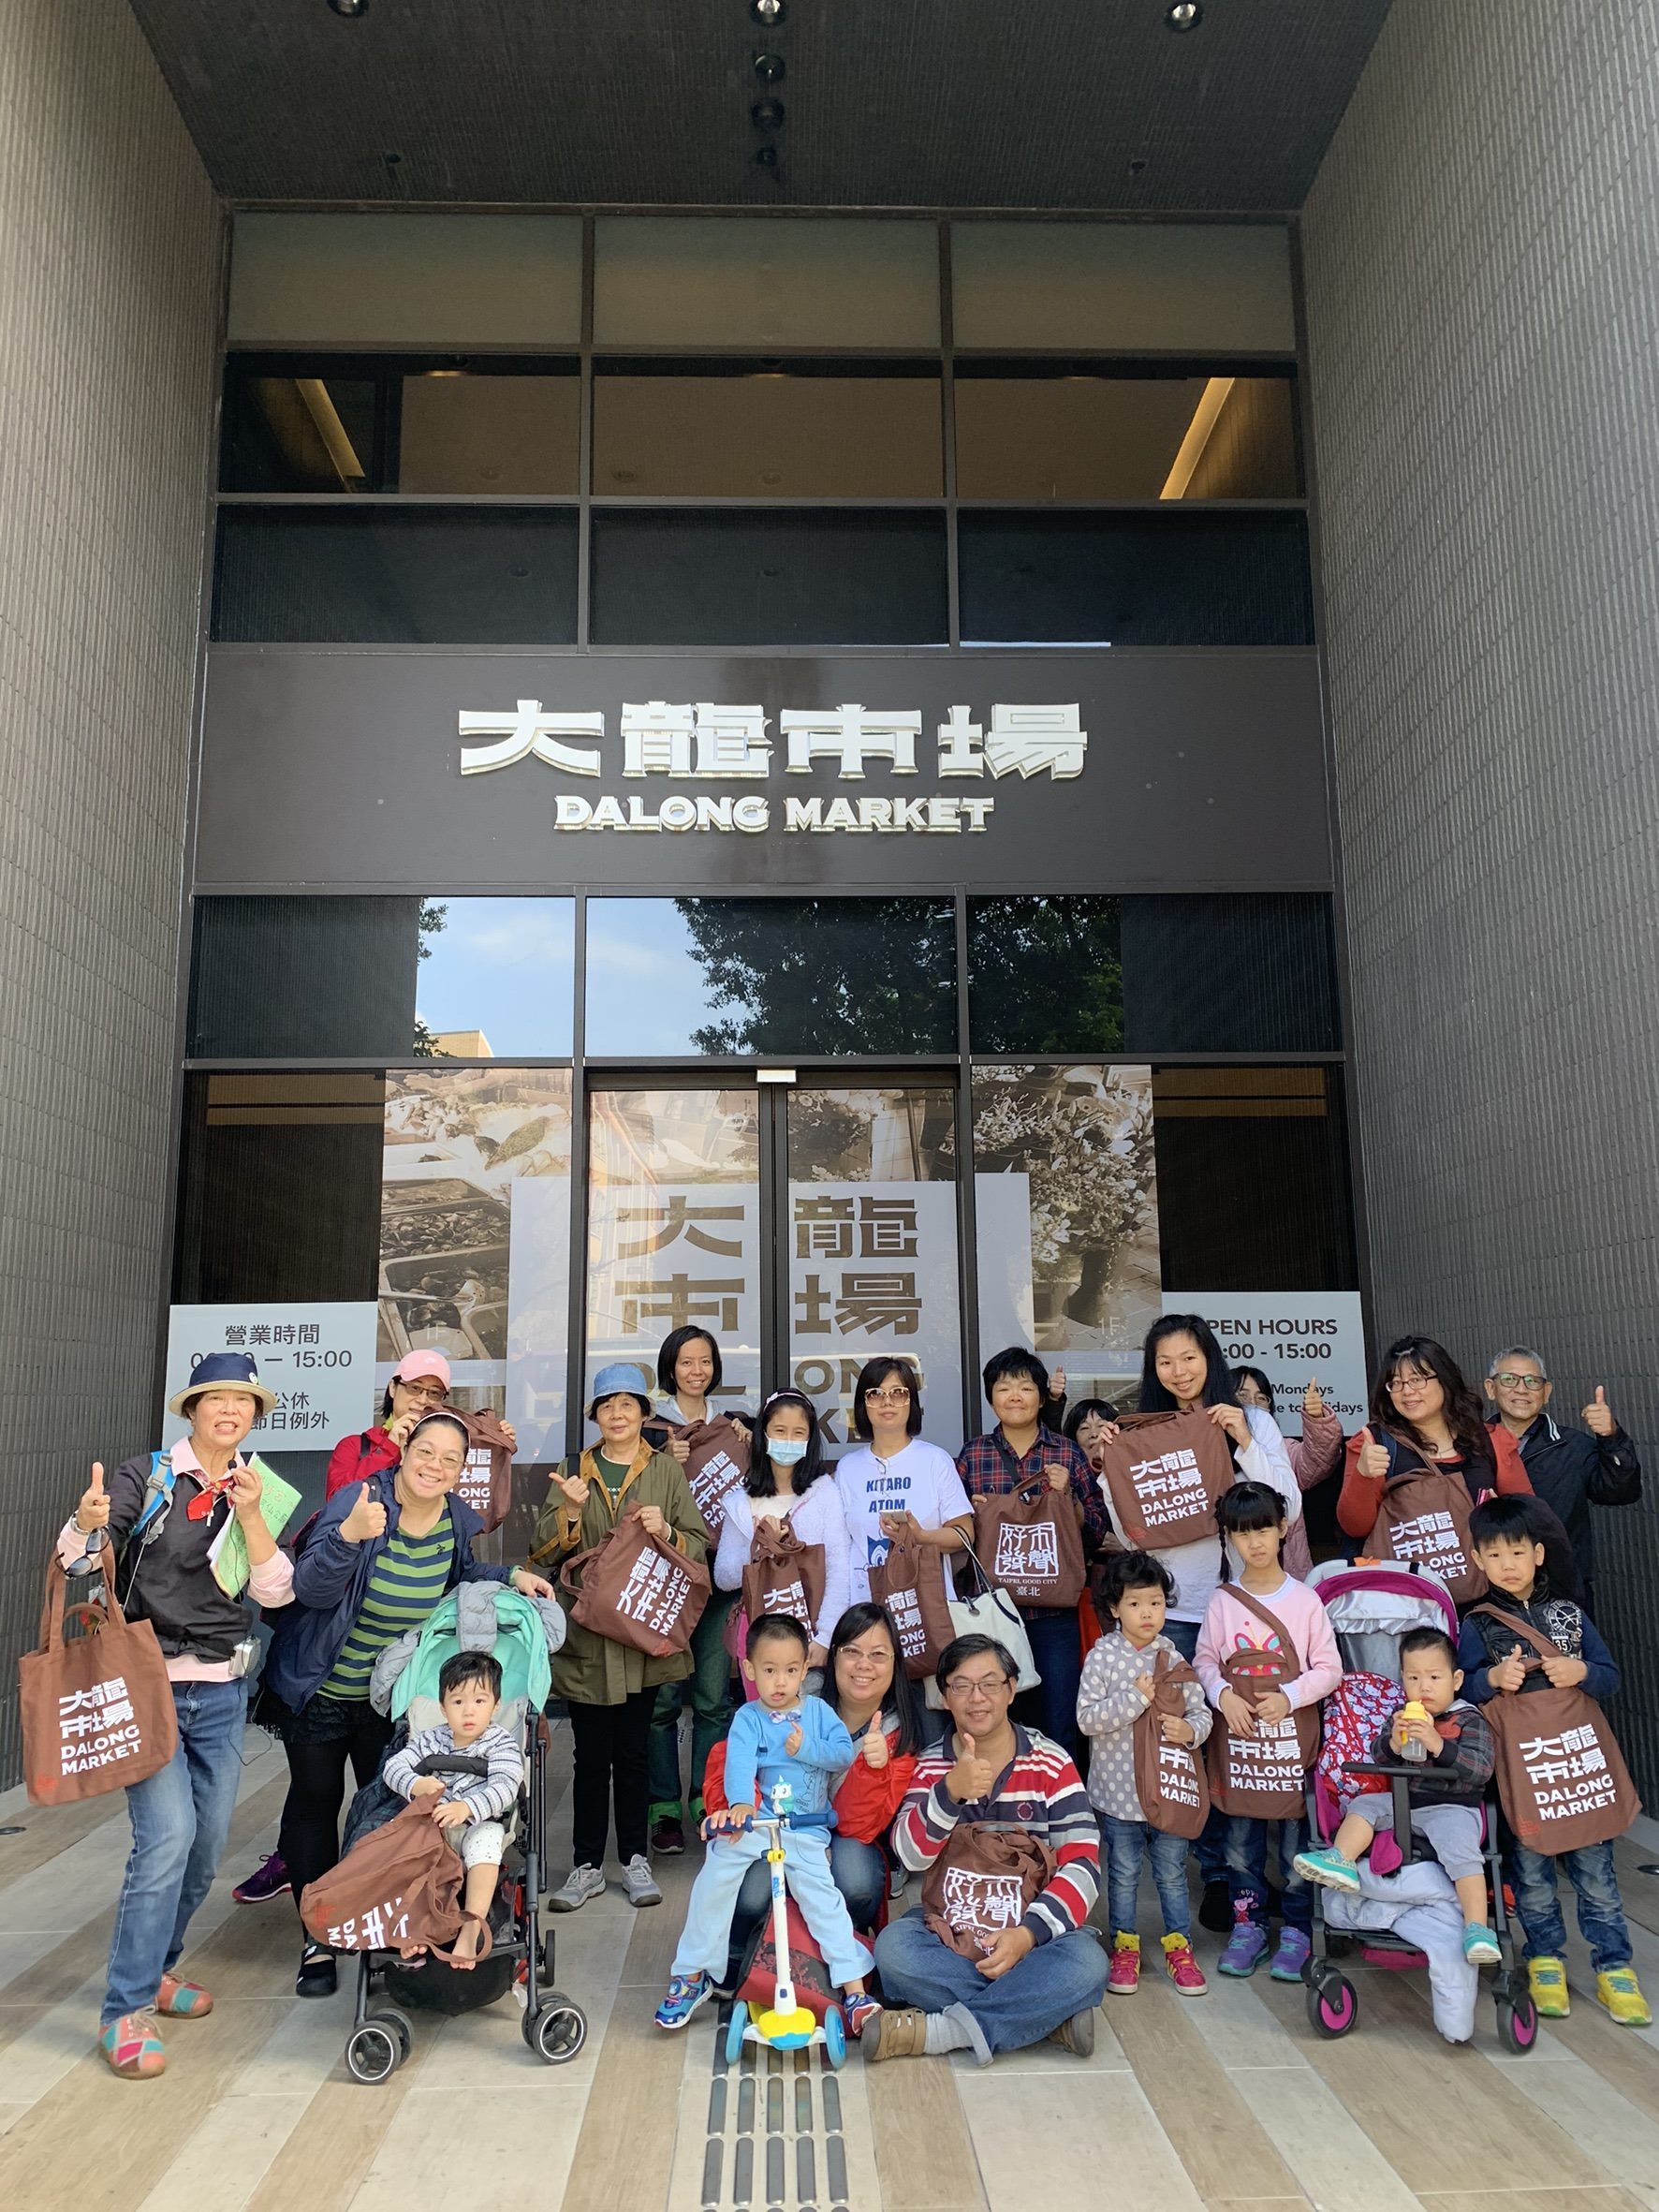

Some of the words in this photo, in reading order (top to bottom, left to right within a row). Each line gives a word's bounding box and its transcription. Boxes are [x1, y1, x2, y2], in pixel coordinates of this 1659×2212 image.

[458, 699, 1088, 780] 大龍市場
[553, 794, 770, 832] DALONG
[784, 795, 994, 832] MARKET
[225, 1324, 320, 1346] 營業時間
[1207, 1319, 1251, 1335] PEN
[1258, 1319, 1338, 1335] HOURS
[292, 1349, 352, 1368] 15:00
[1273, 1342, 1331, 1360] 15:00
[1129, 1448, 1197, 1482] 大龍
[866, 1476, 911, 1493] KITARO
[1134, 1467, 1202, 1498] 市場
[869, 1498, 905, 1512] ATOM
[1140, 1487, 1207, 1514] DALONG
[1144, 1499, 1209, 1527] MARKET
[1389, 1511, 1455, 1541] 大龍
[1392, 1530, 1461, 1559] 市場
[616, 1546, 658, 1615] 大龍
[631, 1556, 672, 1623] 市場
[649, 1566, 683, 1630] DALONG
[58, 1676, 129, 1717] 大龍
[59, 1699, 134, 1739] 市場
[60, 1724, 140, 1760] DALONG
[61, 1739, 141, 1776] MARKET
[1227, 1738, 1301, 1761] 市場
[1519, 1723, 1599, 1762] 大龍
[1229, 1762, 1304, 1777] DALONG
[1526, 1747, 1608, 1785] 市場
[1230, 1777, 1304, 1792] MARKET
[1534, 1774, 1614, 1805] DALONG
[1538, 1789, 1617, 1821] MARKET
